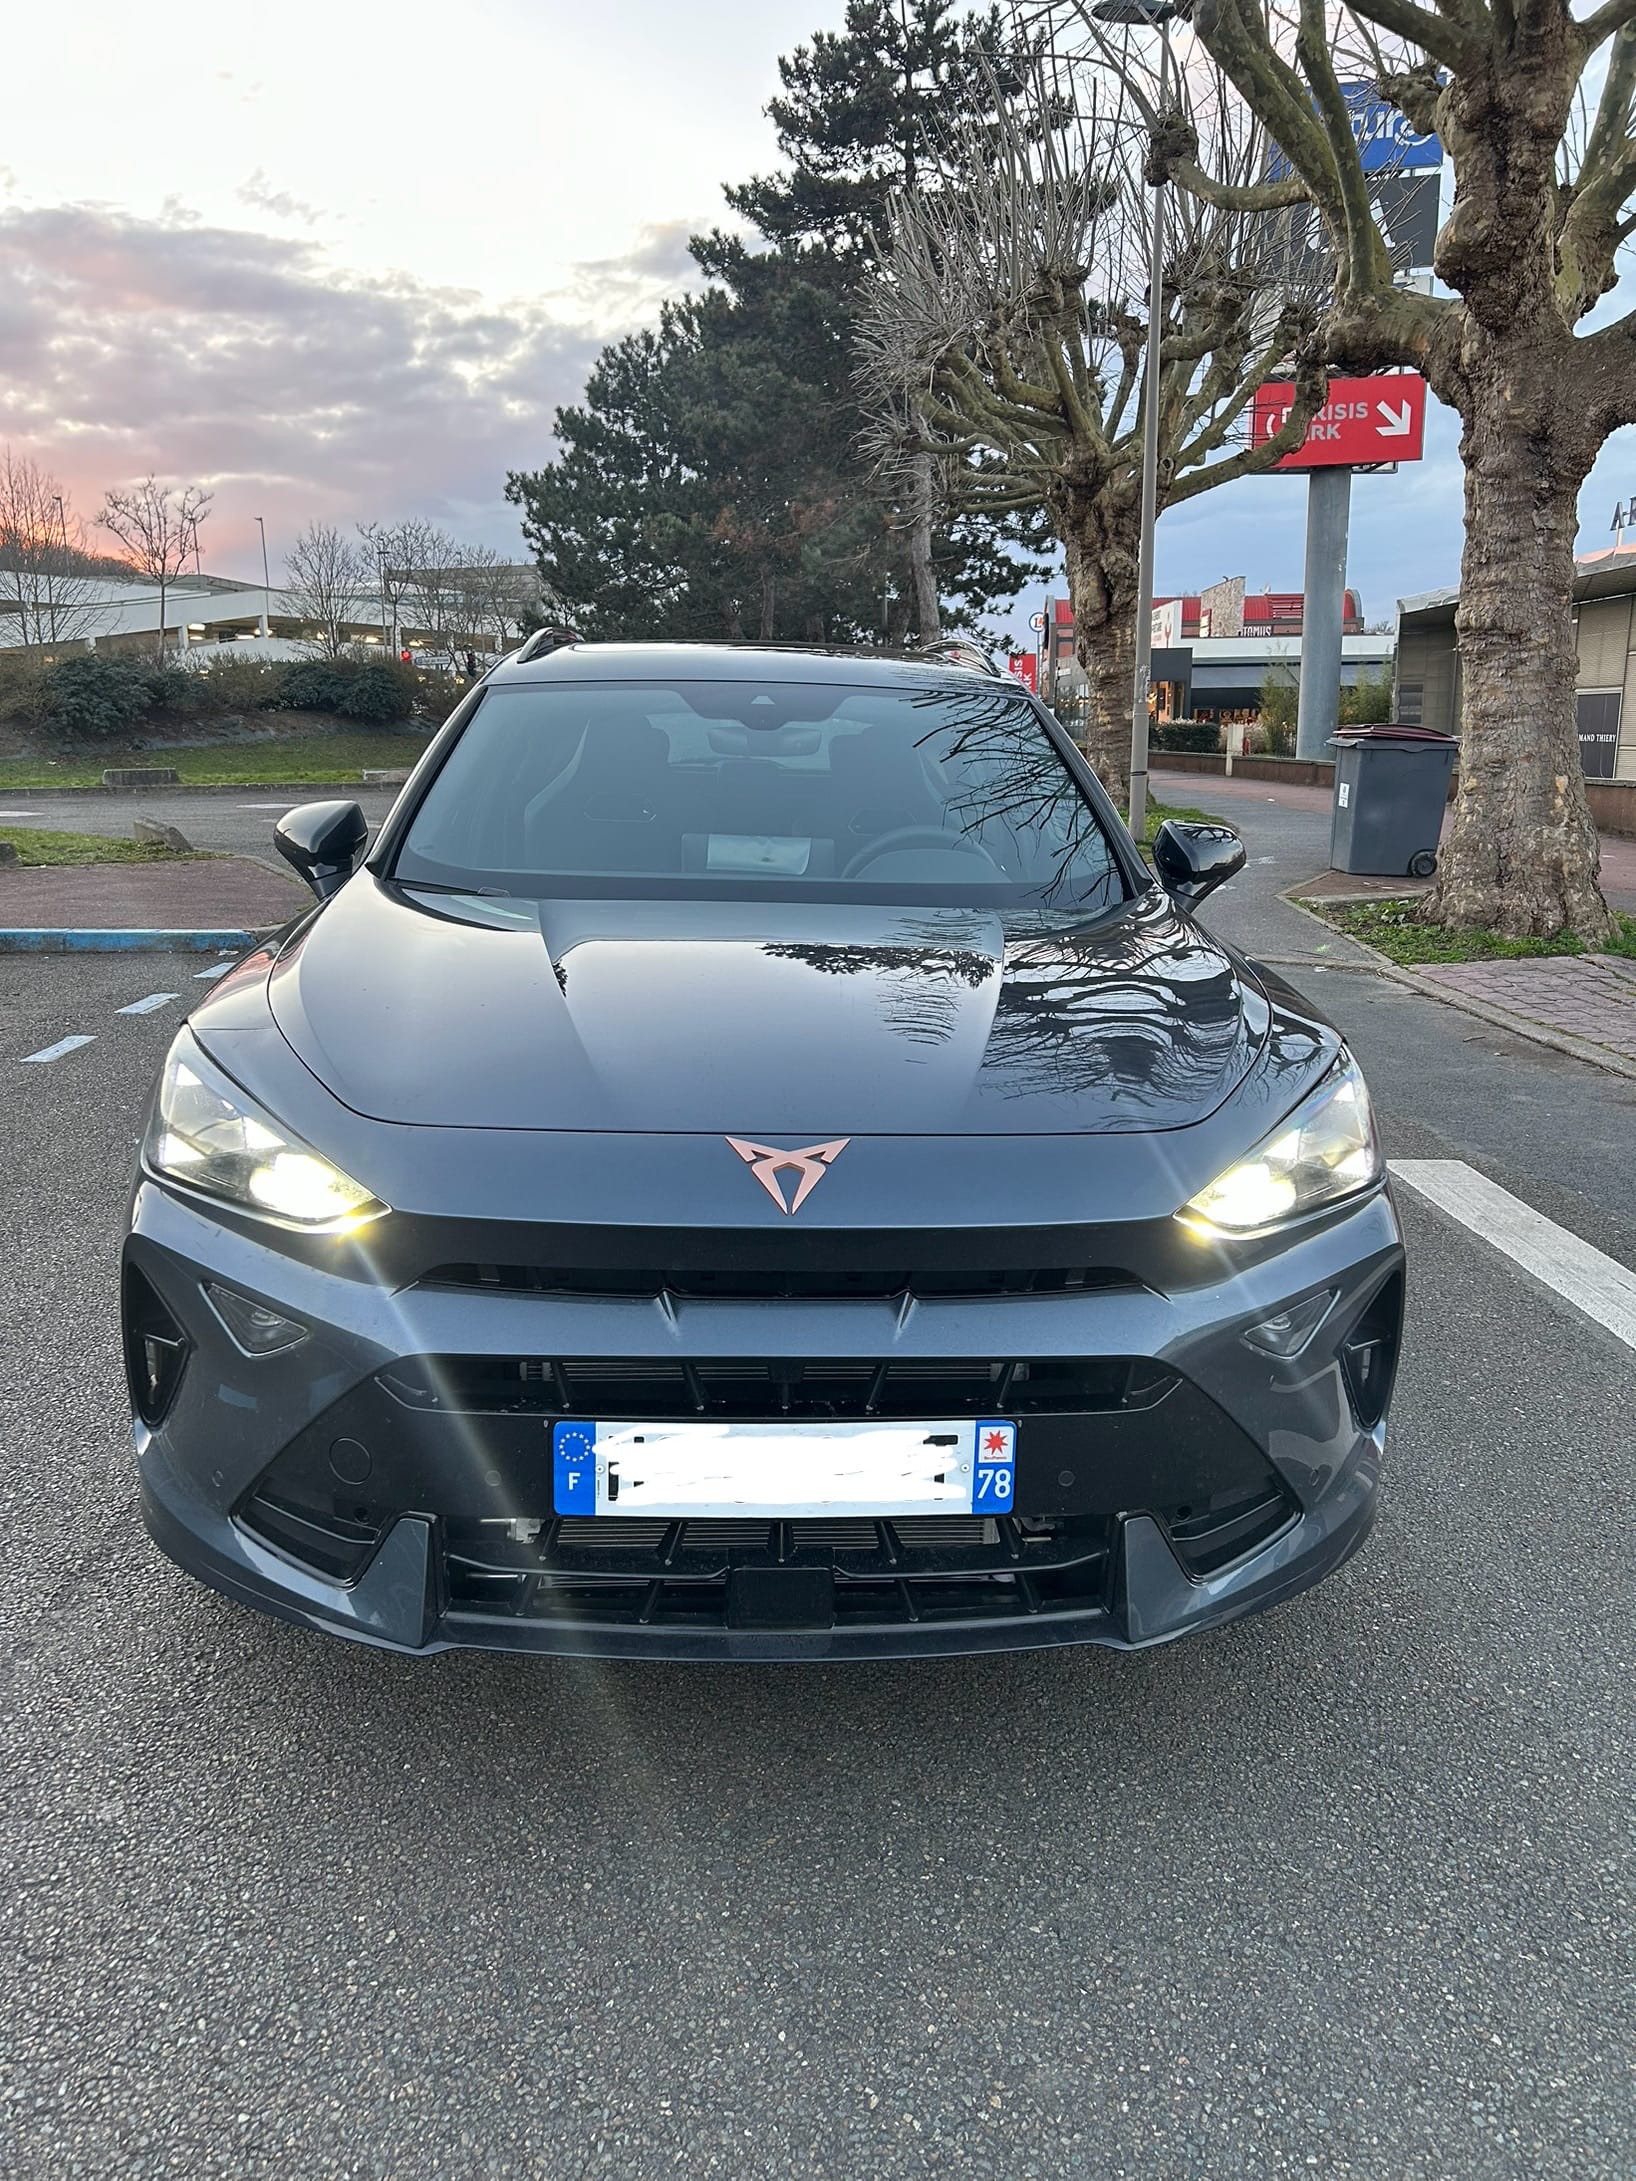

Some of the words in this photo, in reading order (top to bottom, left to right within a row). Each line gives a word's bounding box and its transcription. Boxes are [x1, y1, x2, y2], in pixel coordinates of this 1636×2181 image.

[1579, 733, 1595, 742] MAND
[1596, 733, 1617, 743] THIERY
[568, 1472, 581, 1491] F
[977, 1468, 1011, 1499] 78
